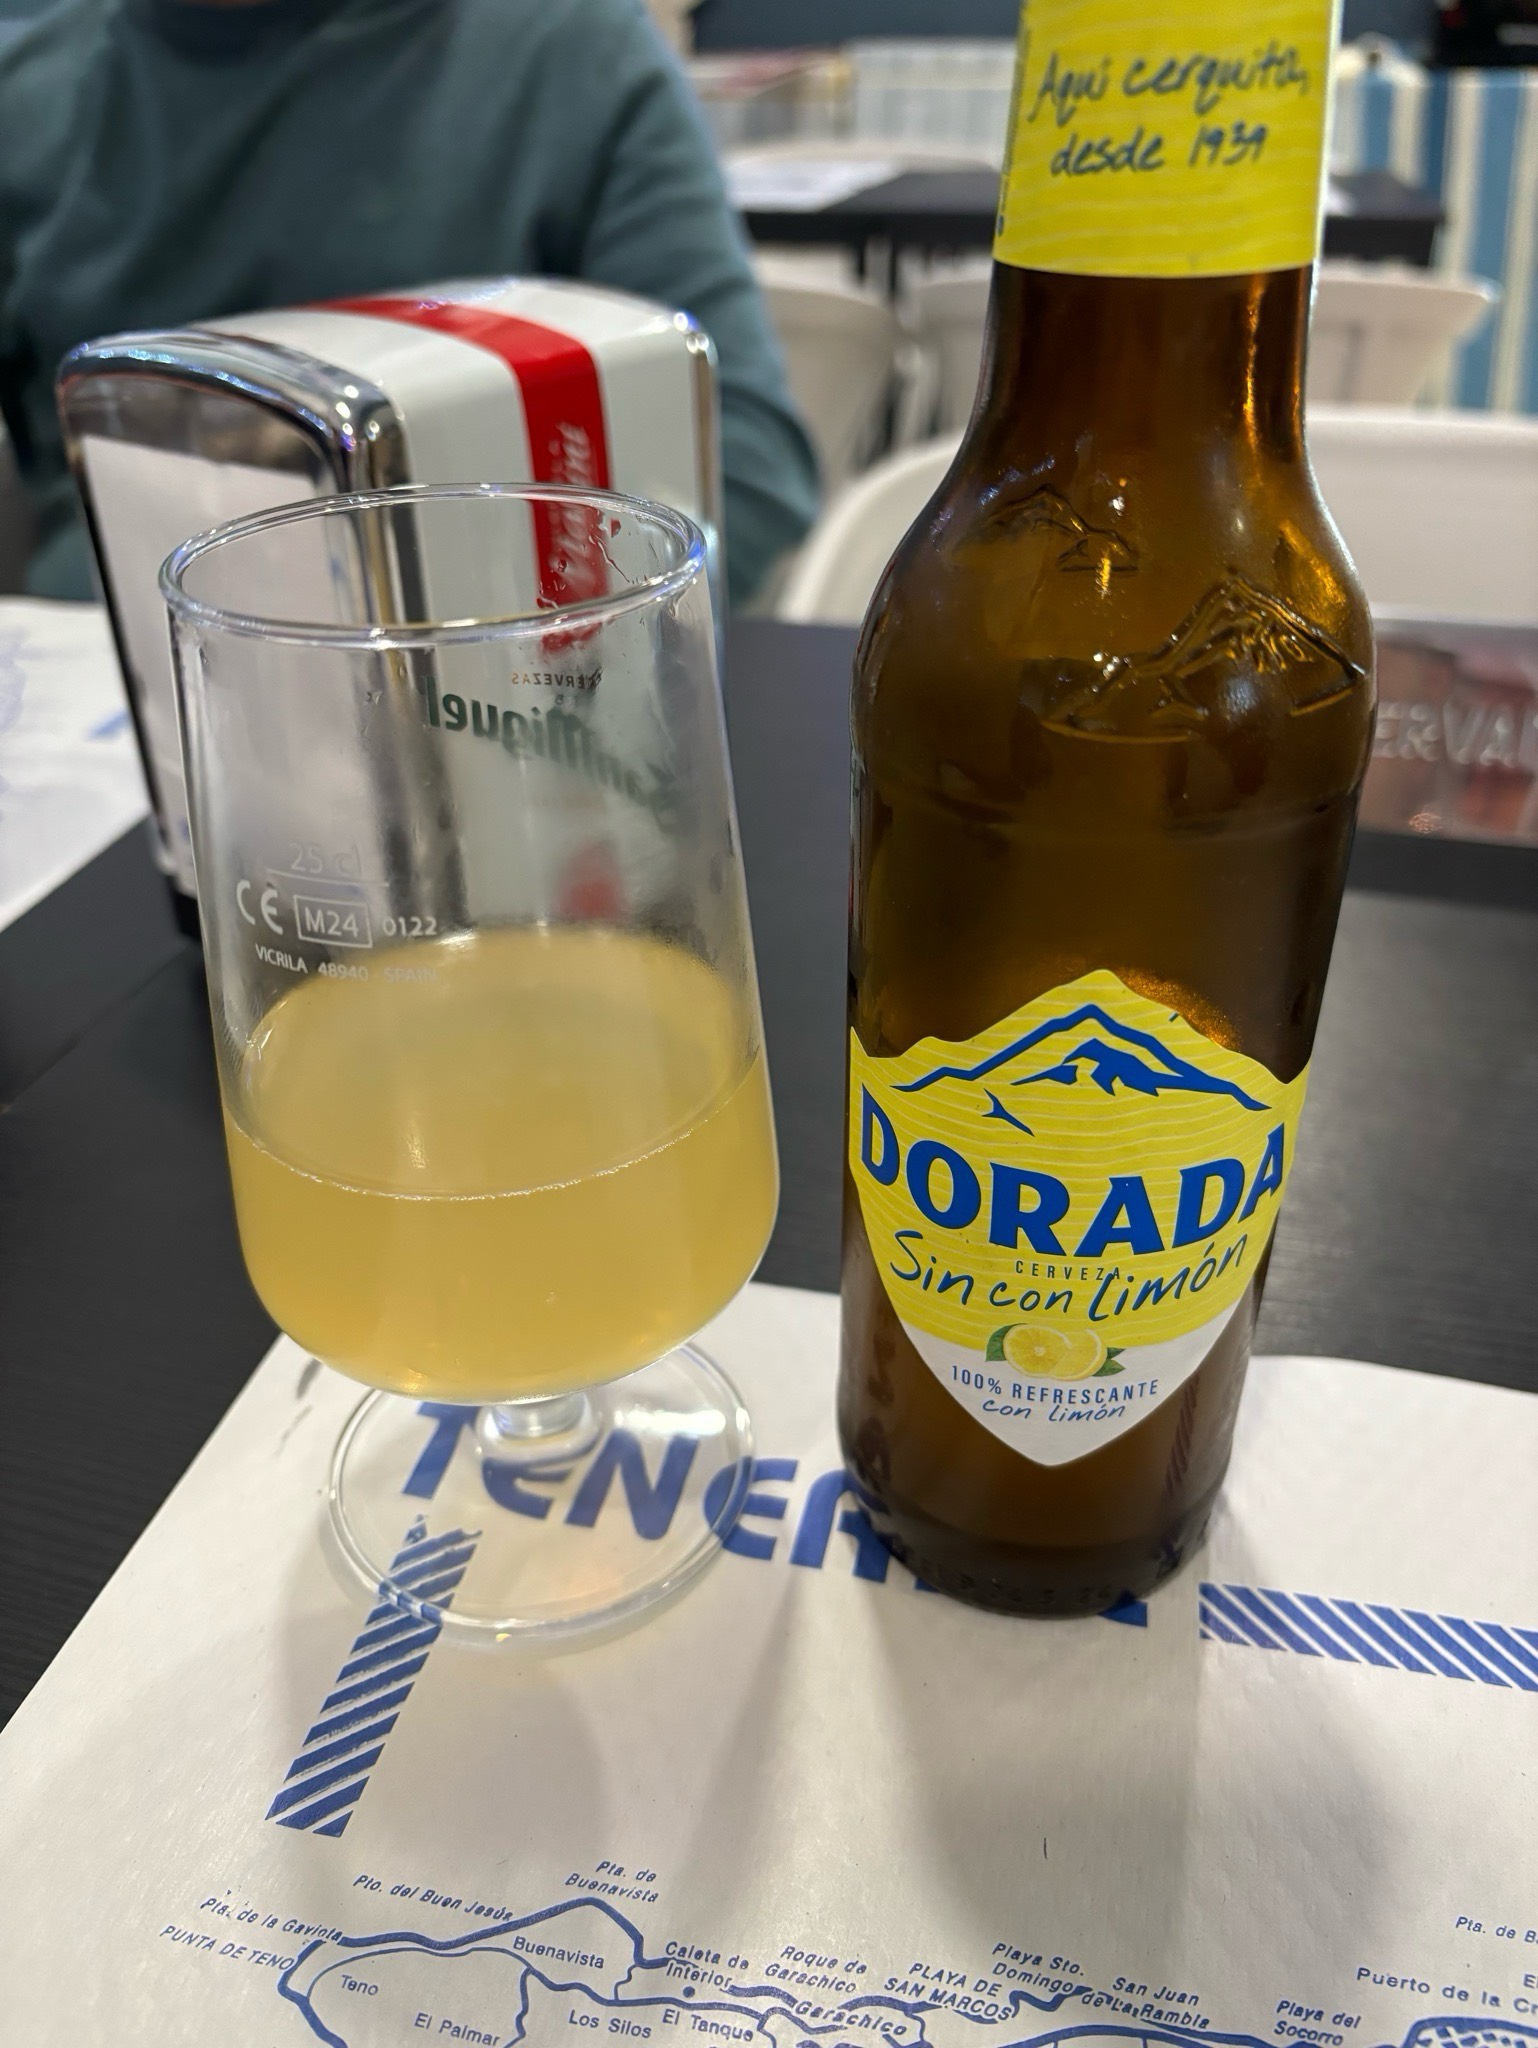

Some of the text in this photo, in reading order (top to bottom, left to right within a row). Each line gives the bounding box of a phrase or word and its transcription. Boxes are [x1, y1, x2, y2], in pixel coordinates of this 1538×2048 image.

[1050, 120, 1268, 177] desde 1939
[290, 843, 362, 878] 25 cl
[305, 906, 359, 938] M24
[383, 916, 438, 937] 0122
[318, 961, 369, 982] 48940
[384, 967, 438, 983] SPAIN
[861, 1083, 1285, 1258] DORADA
[889, 1230, 974, 1306] Sin
[988, 1275, 1072, 1313] con
[1015, 1259, 1122, 1281] CERVEZA
[951, 1364, 1159, 1404] 100% REFRESCANTE
[982, 1400, 1125, 1423] con limón
[565, 1872, 659, 1904] Buenavista
[595, 1860, 657, 1883] Pta. de
[390, 1883, 420, 1899] del
[419, 1889, 463, 1910] Buen
[464, 1900, 514, 1922] Jesús
[236, 1908, 259, 1923] de
[261, 1914, 279, 1929] la
[282, 1919, 343, 1942] Gaviota
[1455, 1916, 1538, 1944] Pta. de B
[159, 1925, 295, 1971] PUNTA DE TENO
[512, 1935, 606, 1969] Buenavista
[665, 1941, 750, 1970] Caleta de
[780, 1945, 868, 1975] Roque de
[992, 1942, 1085, 1977] Playa Sto.
[341, 1974, 379, 1996] Teno
[666, 1962, 733, 1989] Interior
[765, 1963, 857, 1993] Garachico
[908, 1963, 1003, 1998] PLAYA DE
[992, 1962, 1074, 1993] Domingo
[1112, 1976, 1200, 2007] San Juan
[1356, 1967, 1430, 1994] Puerto
[1441, 1985, 1469, 2002] de
[1481, 1991, 1501, 2008] la
[884, 1977, 1014, 2021] SAN MARCOS
[1082, 1991, 1104, 2008] de
[1140, 2003, 1210, 2029] Rambla
[1276, 1999, 1362, 2029] Playa del
[413, 2012, 501, 2047] El Palmar
[569, 2009, 652, 2039] Los Silos
[662, 2008, 754, 2042] El Tanque
[795, 2001, 907, 2036] Garachico
[1273, 2020, 1344, 2047] Socorro
